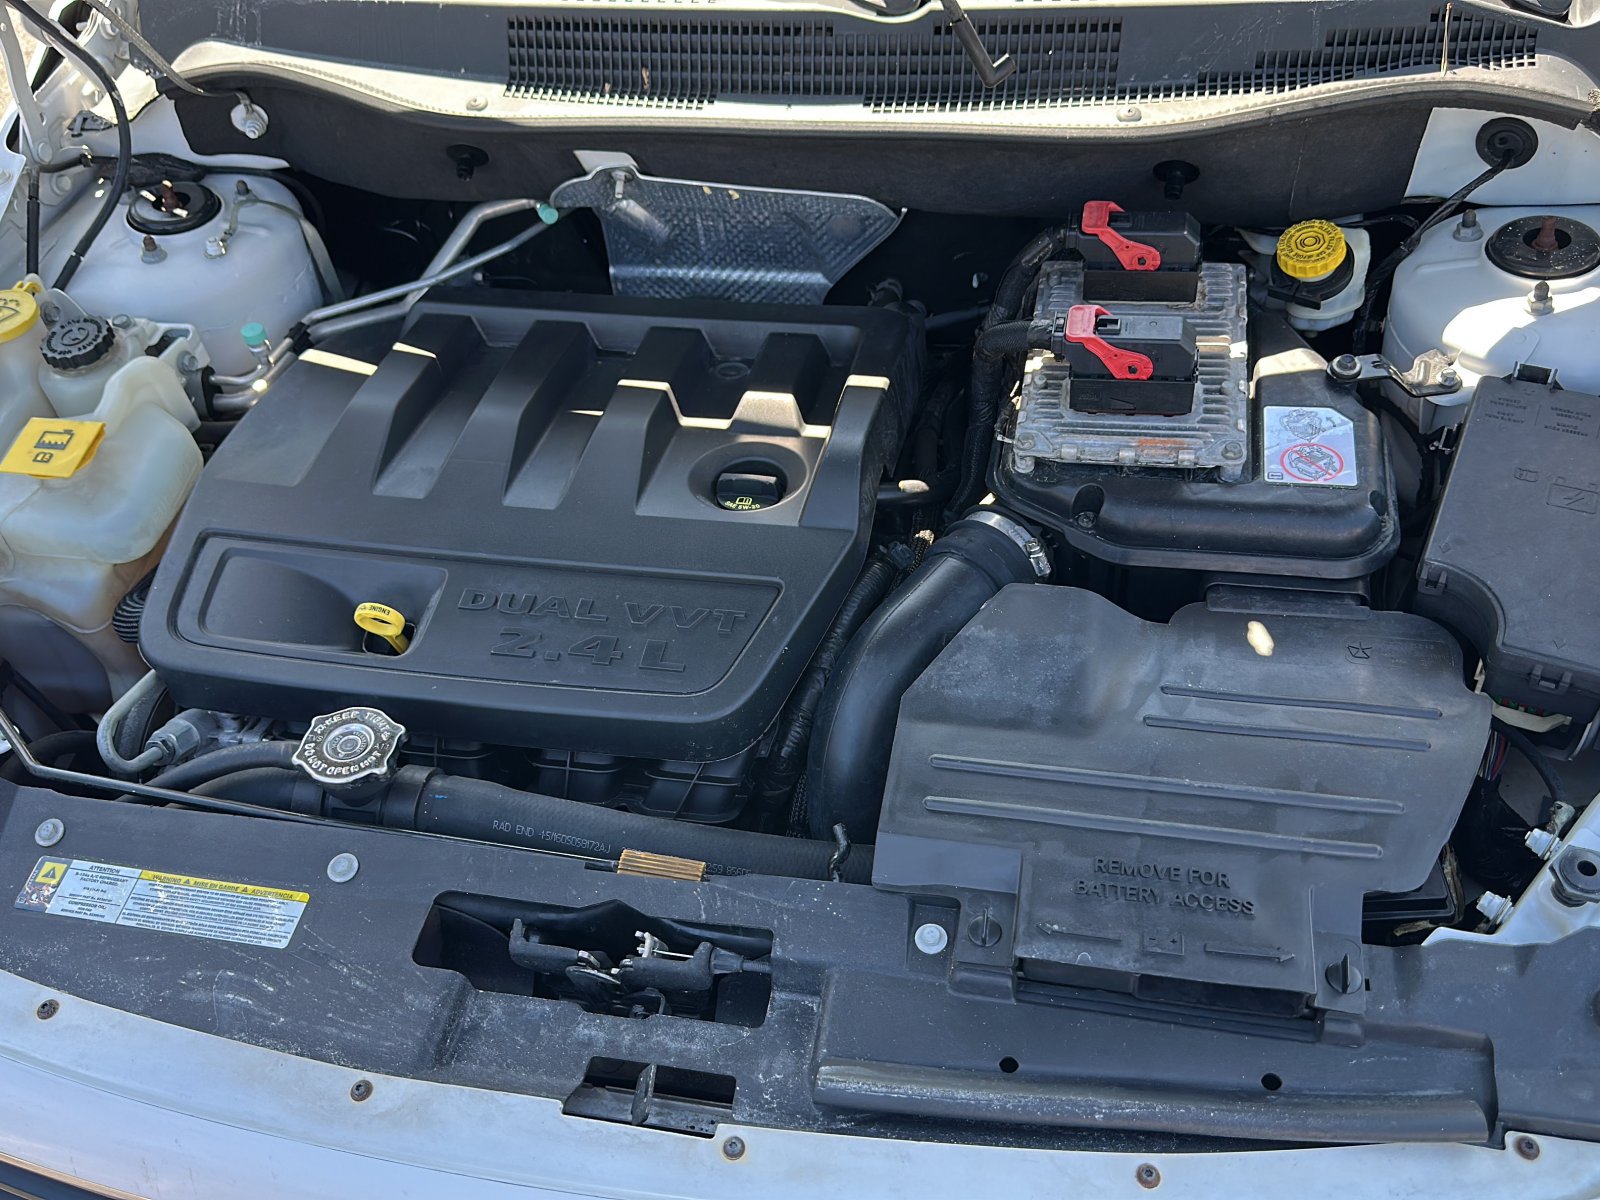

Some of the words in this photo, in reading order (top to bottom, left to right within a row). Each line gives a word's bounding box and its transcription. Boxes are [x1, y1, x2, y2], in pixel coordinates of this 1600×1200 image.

[725, 501, 738, 509] SAE
[368, 604, 391, 616] ENGINE
[457, 588, 609, 623] DUAL
[624, 602, 746, 633] VVT
[326, 765, 360, 776] OPEN
[492, 820, 511, 832] RAD
[515, 825, 534, 837] END
[89, 865, 120, 874] ATTENTION
[1094, 857, 1183, 883] REMOVE
[1187, 866, 1231, 889] FOR
[152, 874, 182, 883] WARNING
[218, 884, 240, 892] GARDE
[251, 889, 293, 899] ADVERTENCIA
[1074, 879, 1161, 904] BATTERY
[1170, 890, 1256, 917] ACCESS
